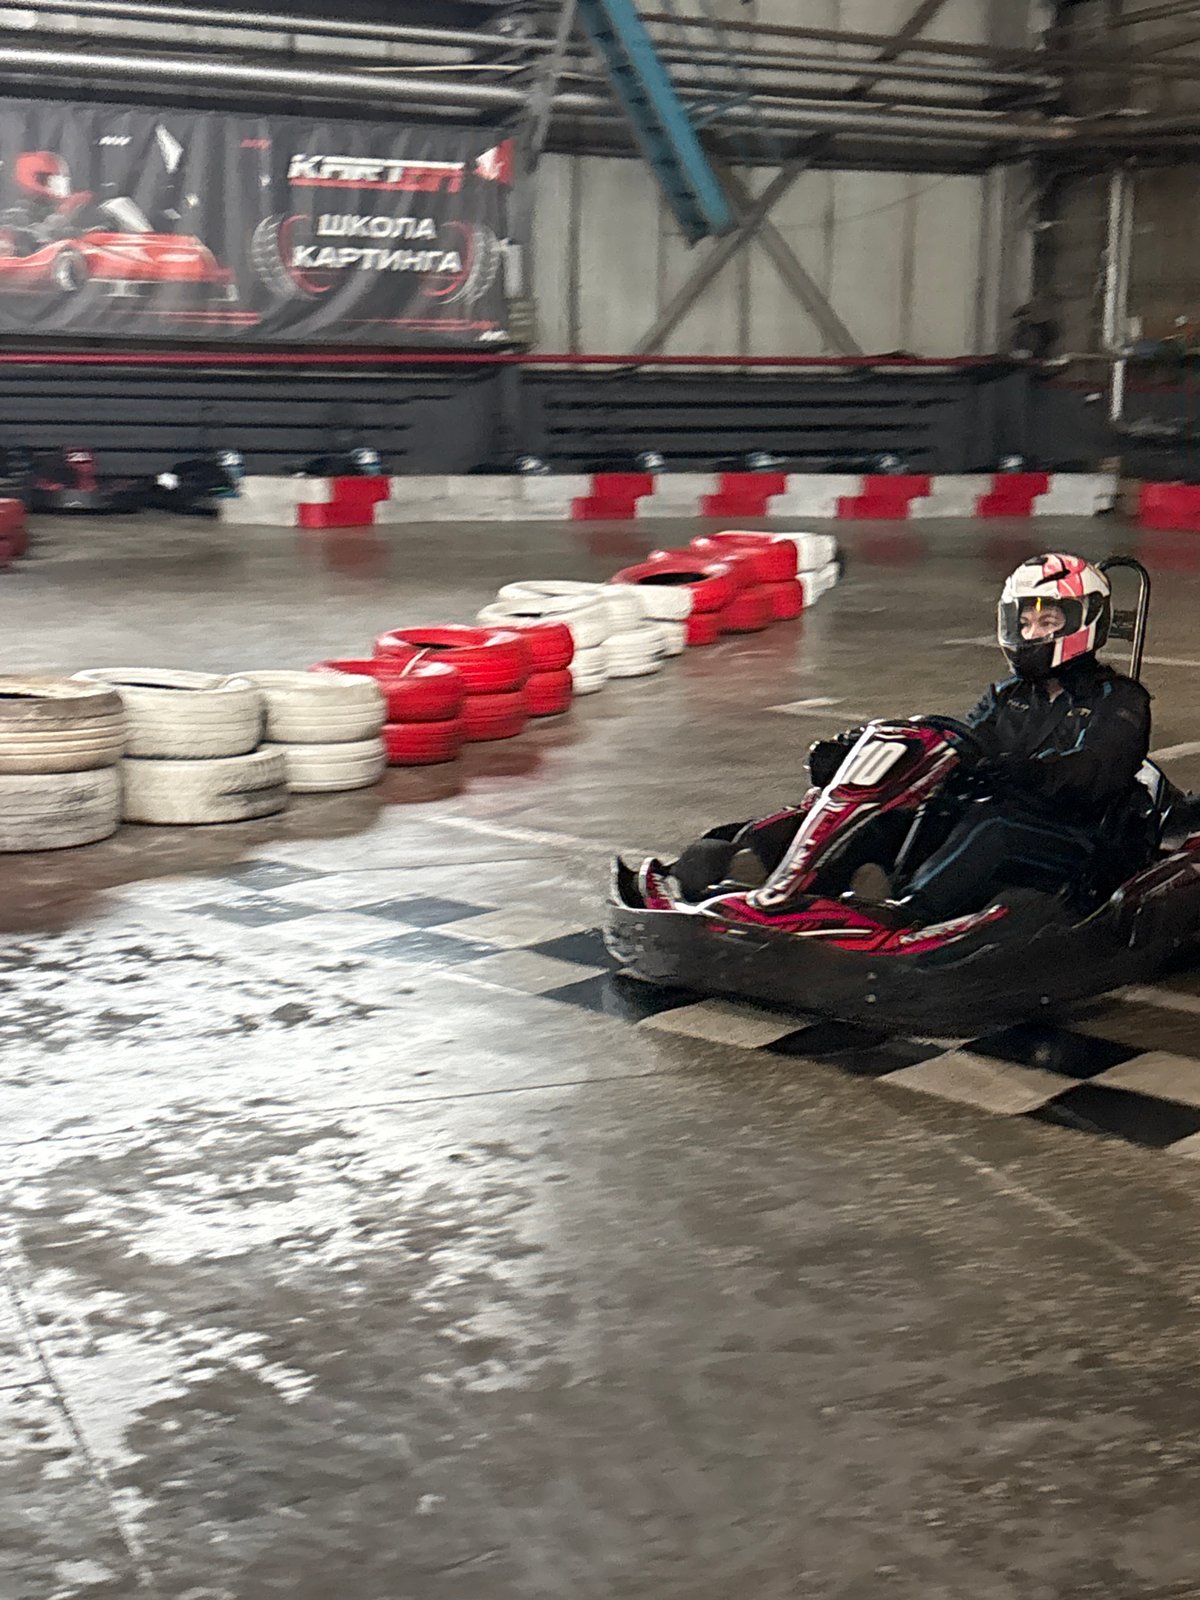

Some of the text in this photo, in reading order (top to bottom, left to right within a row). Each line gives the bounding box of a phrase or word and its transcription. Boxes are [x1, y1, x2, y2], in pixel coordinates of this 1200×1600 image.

[316, 213, 437, 240] ШКОЛА
[291, 245, 463, 273] КАРТИНГА
[840, 740, 908, 786] 10
